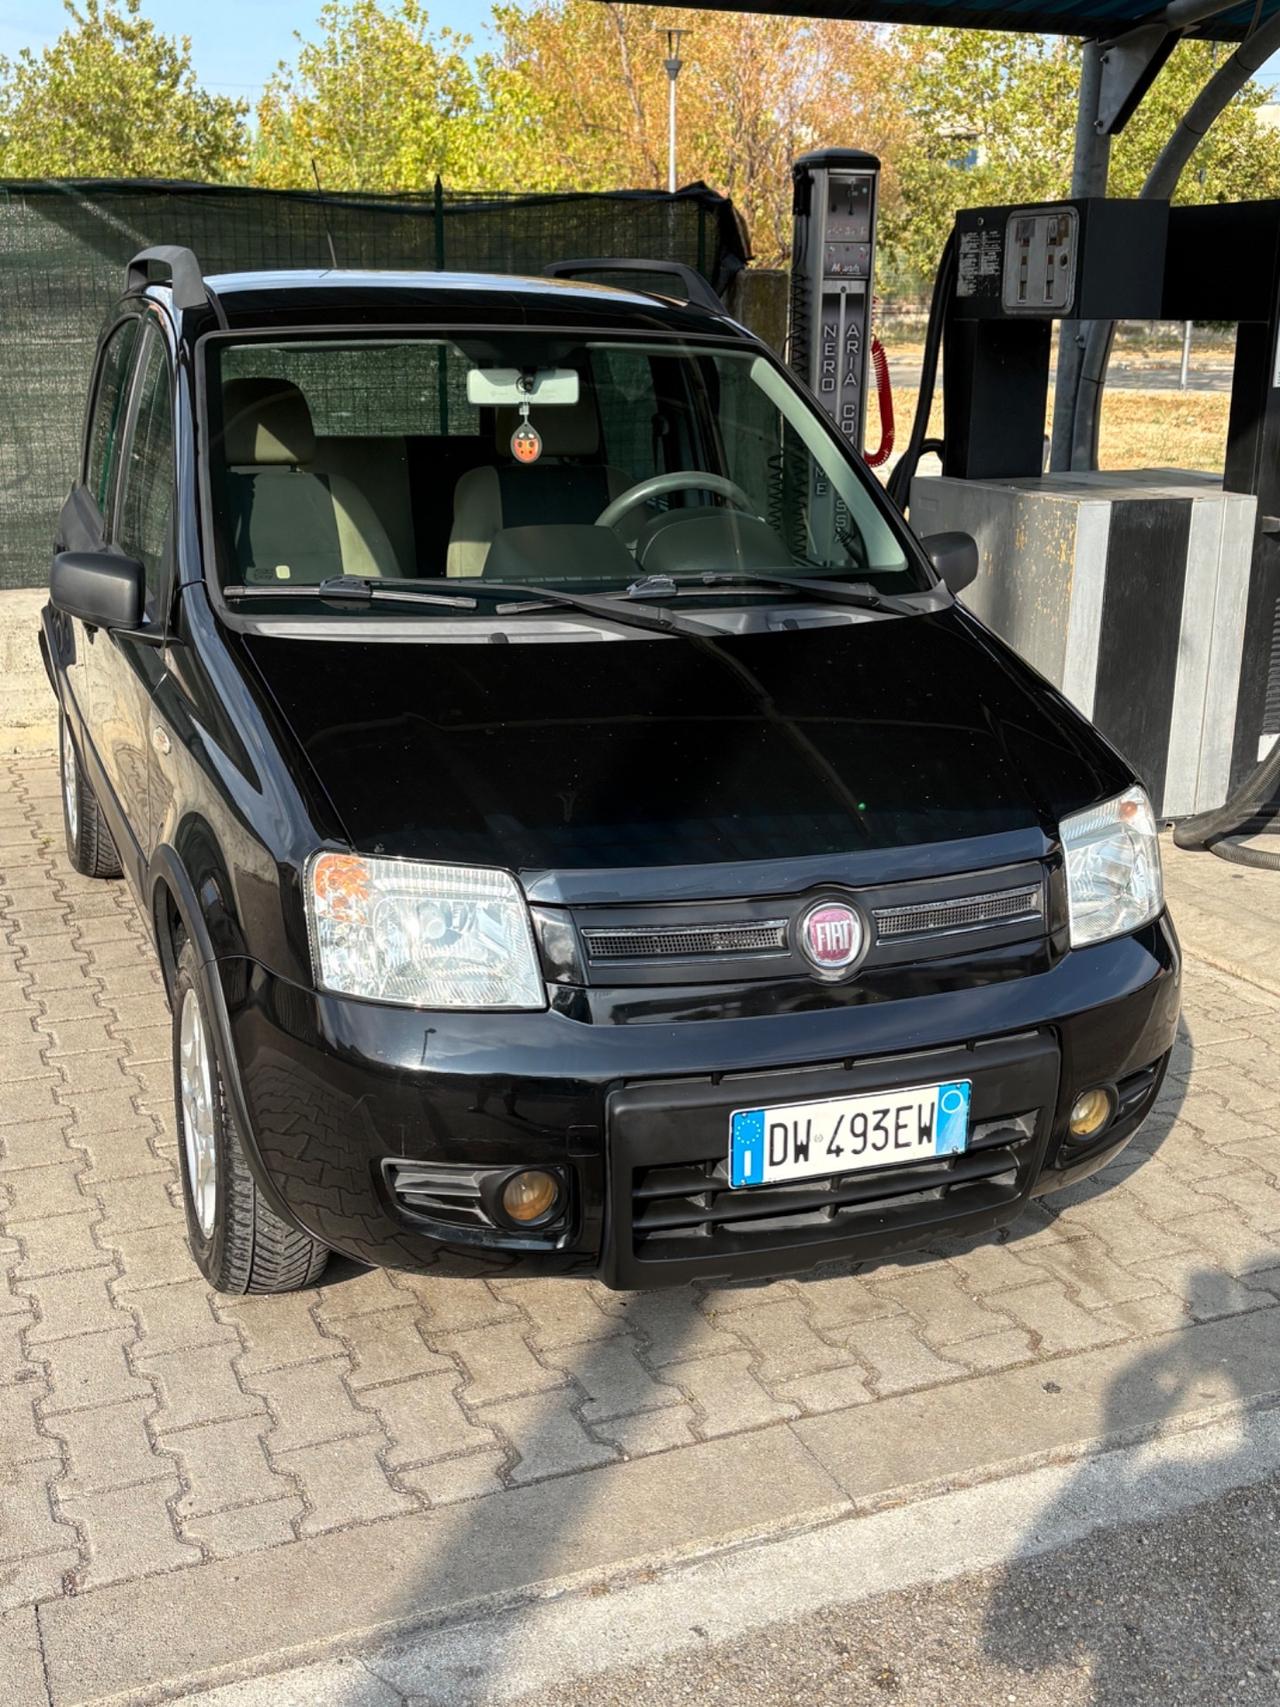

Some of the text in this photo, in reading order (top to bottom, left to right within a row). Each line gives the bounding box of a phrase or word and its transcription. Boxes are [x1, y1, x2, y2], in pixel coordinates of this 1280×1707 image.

[821, 324, 837, 392] NERO
[843, 323, 860, 386] ARIA
[815, 919, 851, 953] FIAT
